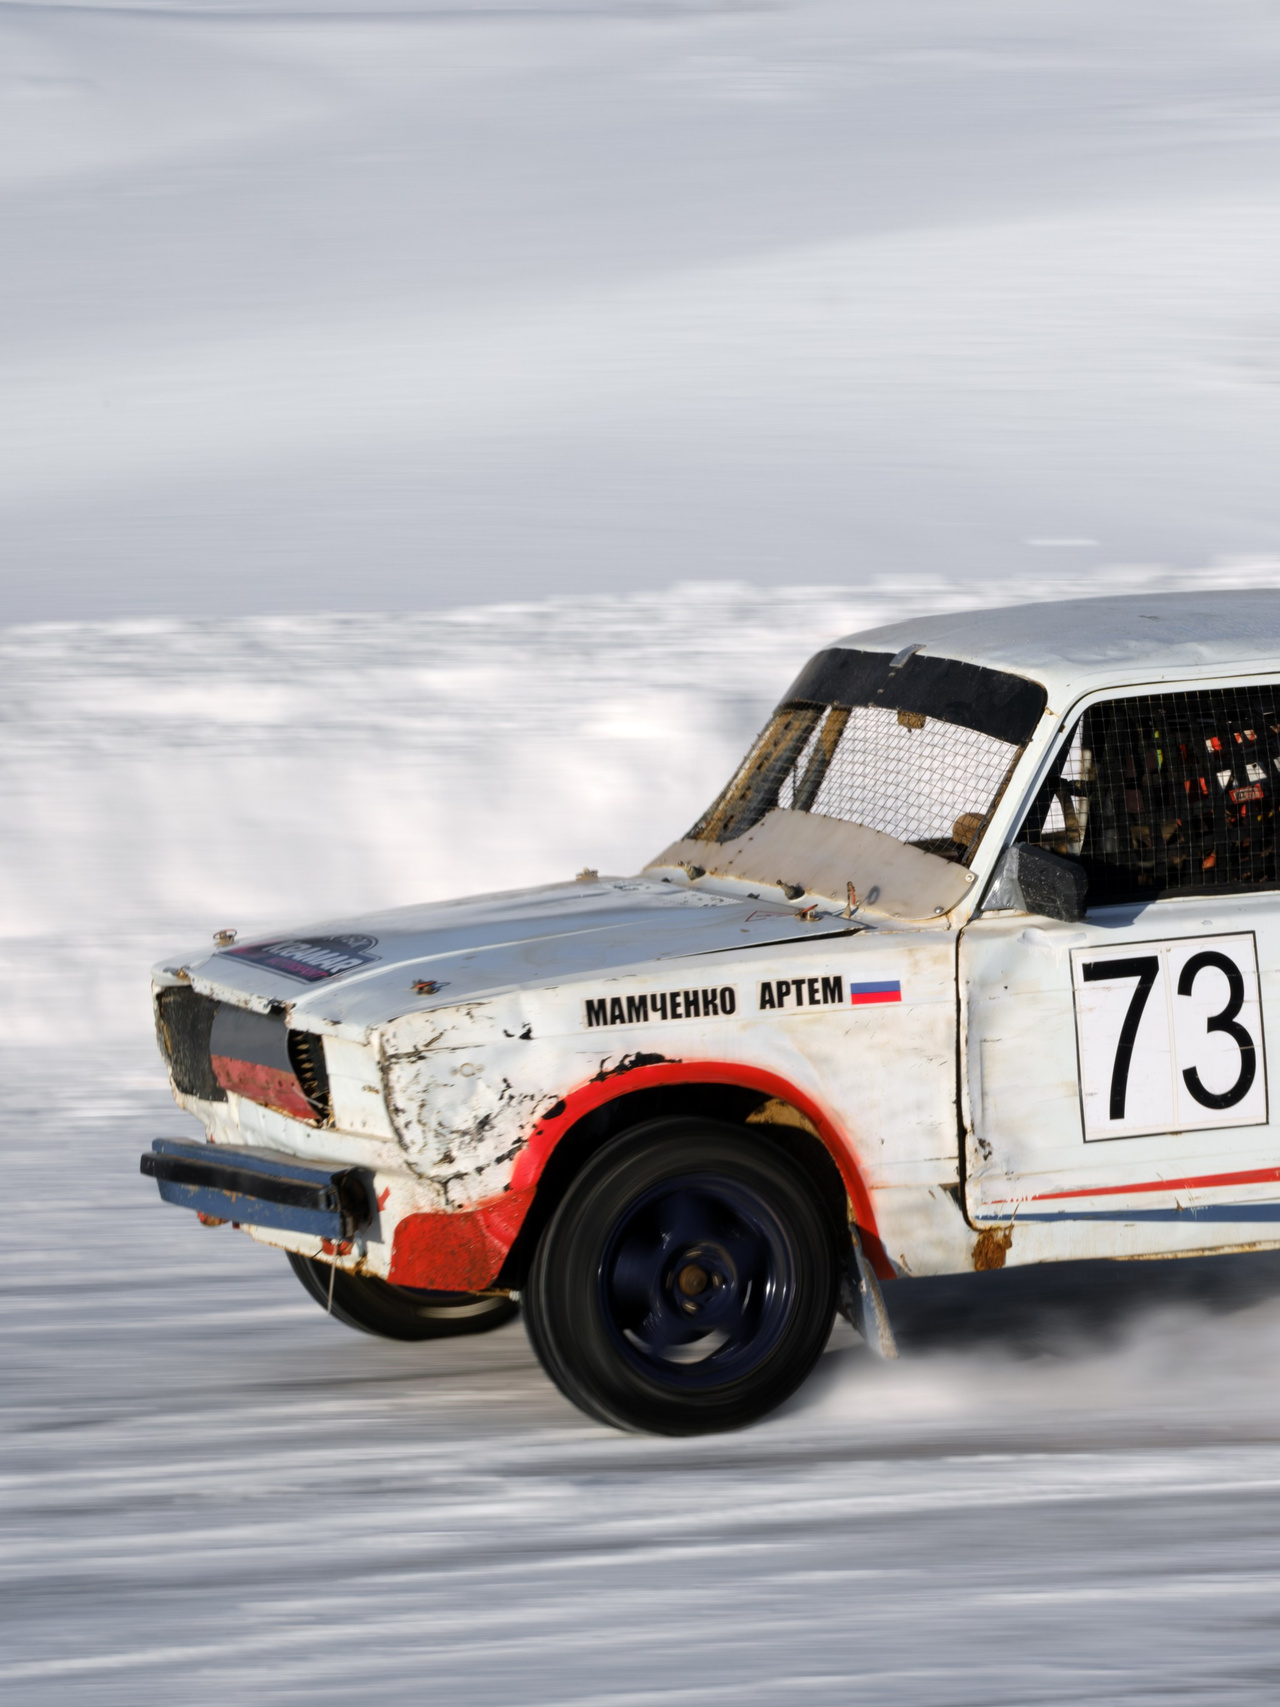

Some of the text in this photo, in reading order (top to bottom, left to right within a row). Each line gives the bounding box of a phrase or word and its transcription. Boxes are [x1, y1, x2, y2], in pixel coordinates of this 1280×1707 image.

[585, 975, 844, 1028] МАМЧЕНКО АРТЕМ
[1081, 950, 1257, 1121] 73
